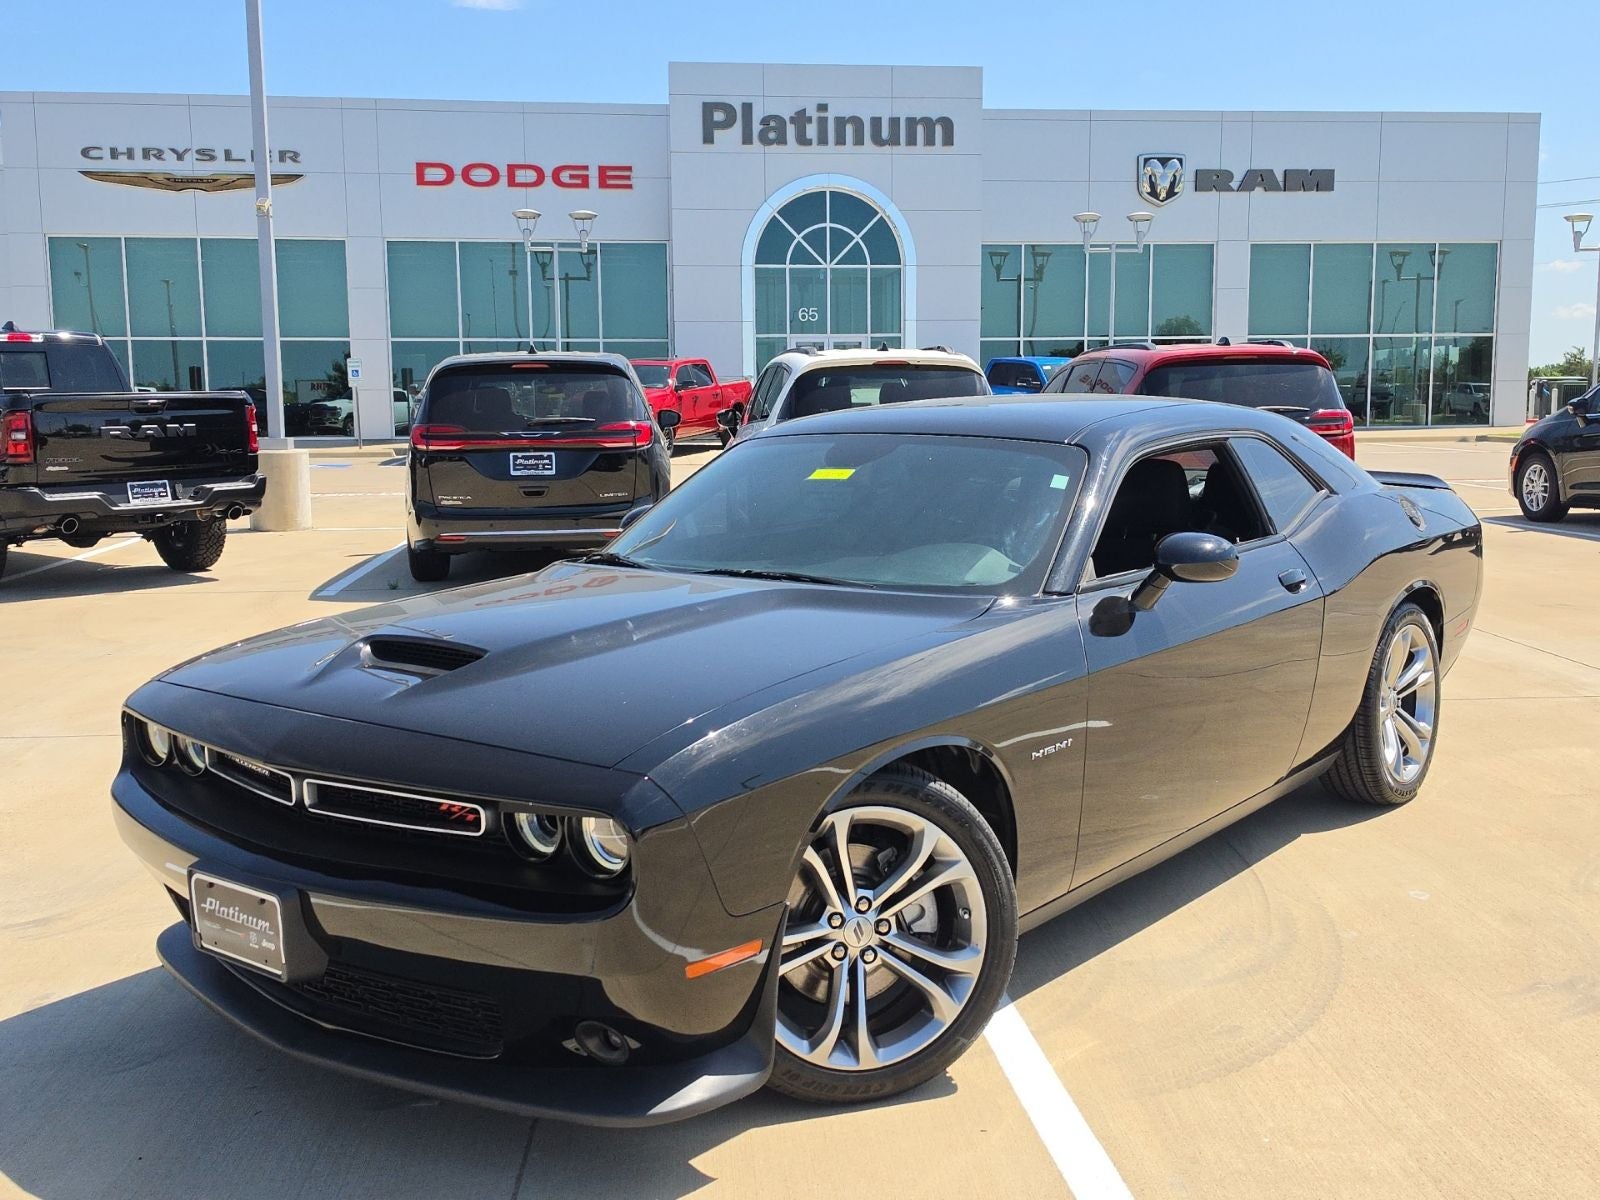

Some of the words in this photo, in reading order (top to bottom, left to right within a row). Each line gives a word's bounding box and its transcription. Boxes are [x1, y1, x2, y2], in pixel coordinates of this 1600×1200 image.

[702, 101, 955, 147] Platinum
[415, 162, 633, 190] DODGE
[1195, 168, 1335, 192] RAM
[798, 307, 819, 322] 65
[100, 423, 196, 439] RAM
[439, 802, 480, 821] R/T
[201, 897, 274, 935] Platinum
